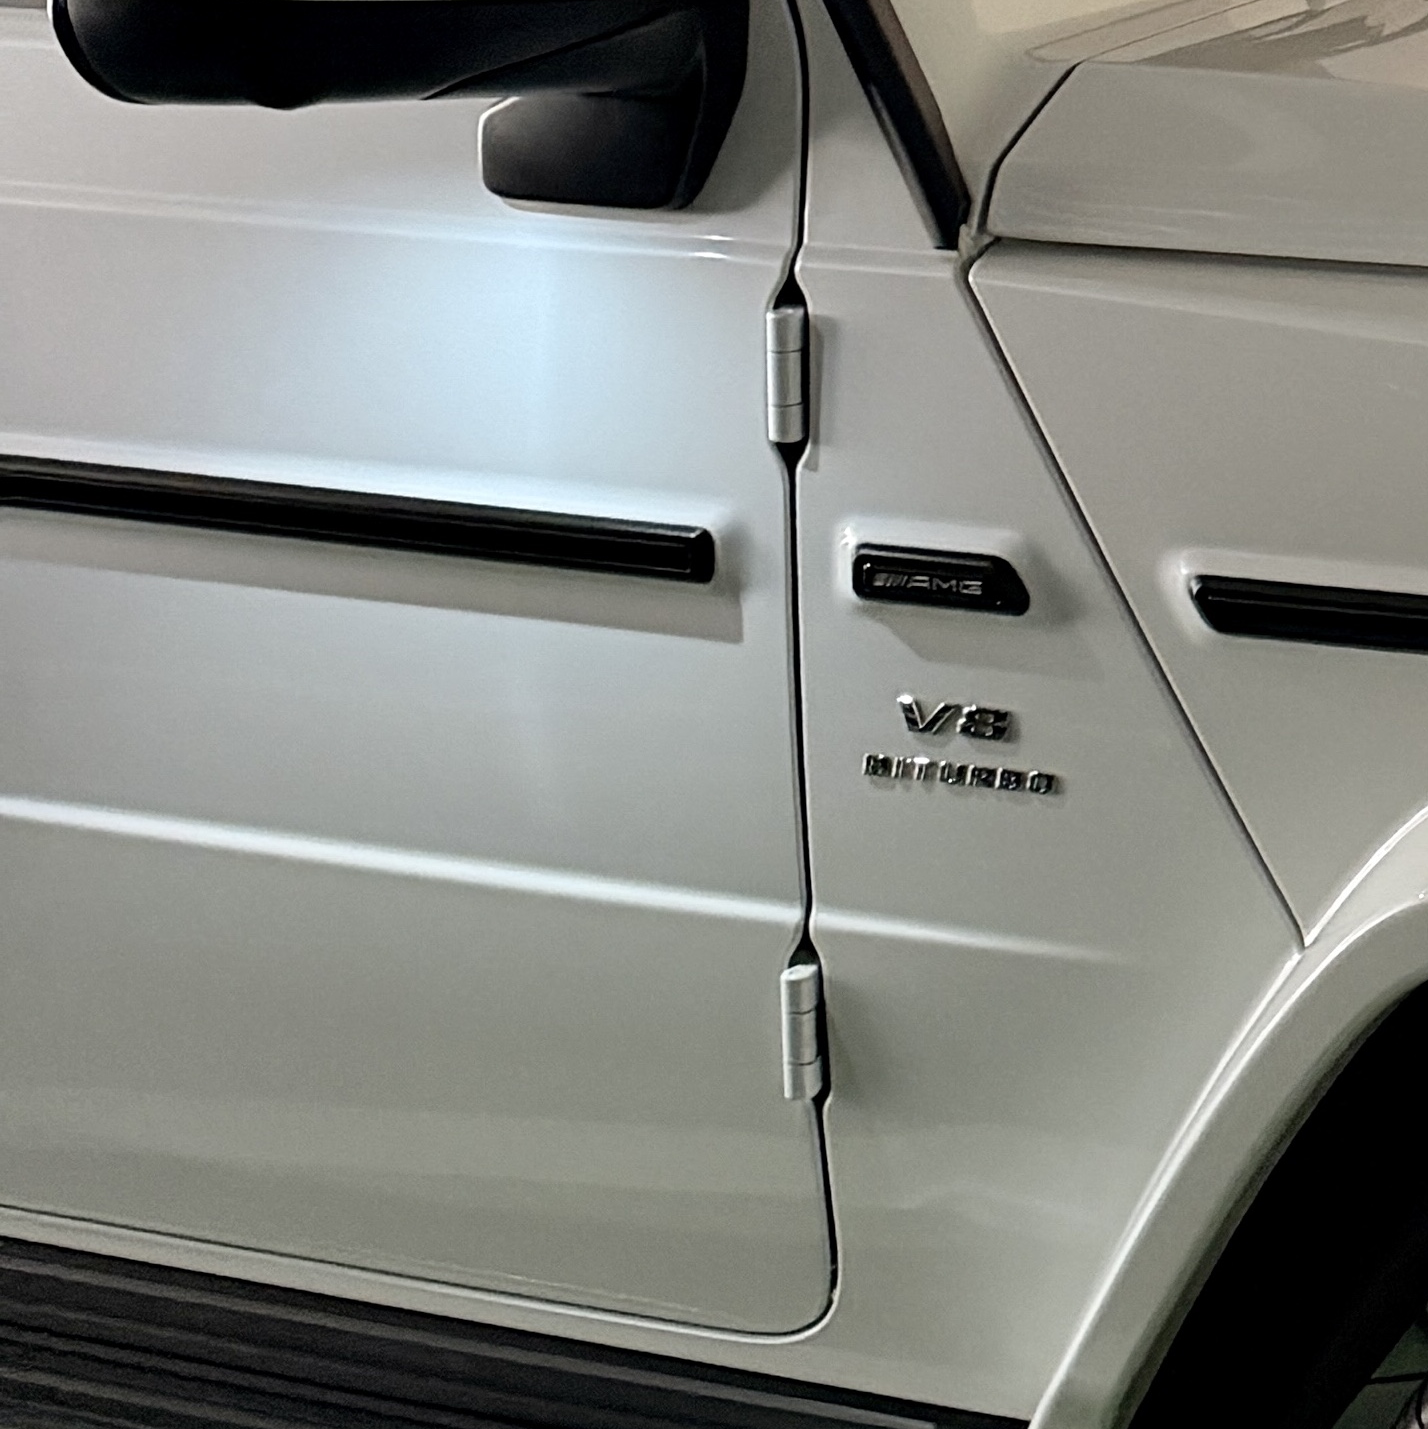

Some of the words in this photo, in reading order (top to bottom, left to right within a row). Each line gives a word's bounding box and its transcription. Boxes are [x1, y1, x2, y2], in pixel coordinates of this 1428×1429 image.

[906, 575, 983, 595] AMG
[897, 694, 1009, 741] V8
[862, 753, 1055, 794] BITURBO
